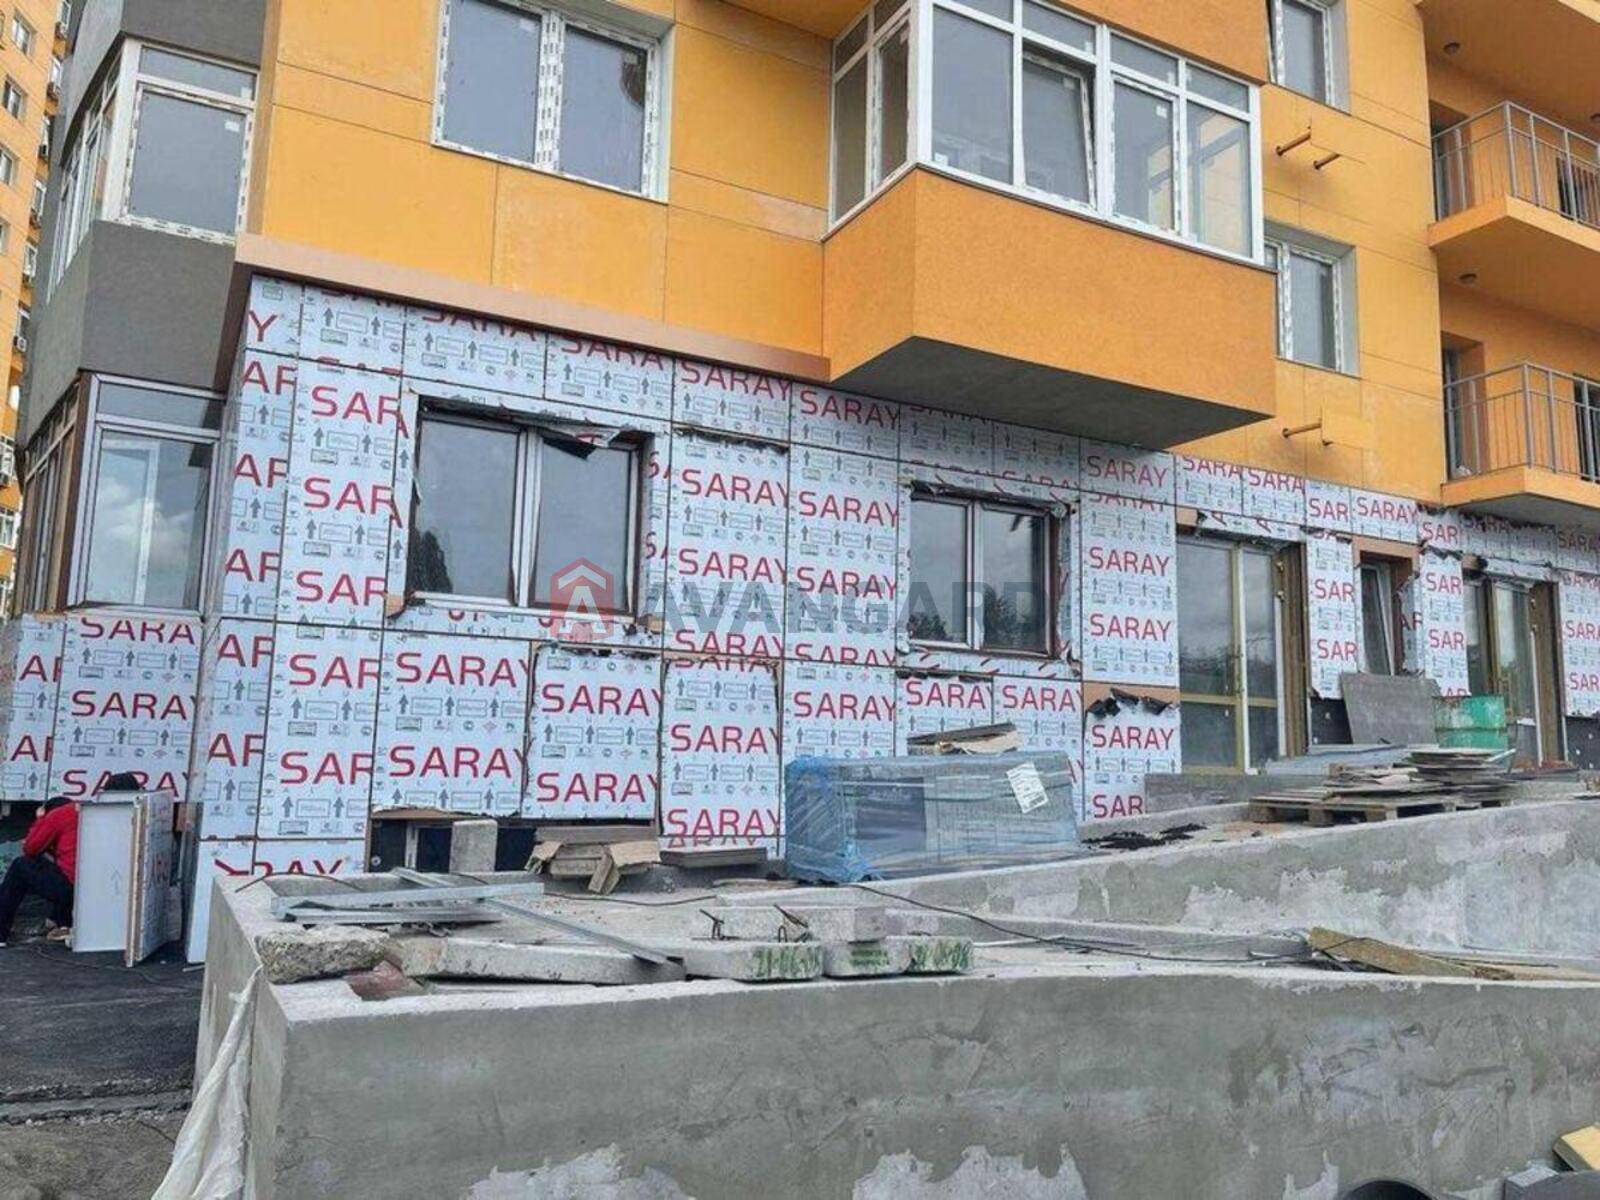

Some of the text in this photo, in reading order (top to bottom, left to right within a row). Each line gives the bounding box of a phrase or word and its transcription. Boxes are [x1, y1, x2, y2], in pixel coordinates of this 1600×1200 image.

[681, 360, 791, 400] SARAY
[801, 390, 900, 430] SARAY
[1087, 455, 1168, 488] SARAY
[798, 490, 900, 528] SARAY
[1357, 496, 1418, 524] SARAY
[1422, 522, 1458, 544] SAR
[1089, 546, 1170, 577] SARAY
[797, 567, 897, 600] SARAY
[1425, 572, 1462, 594] SAR
[1090, 613, 1172, 643] SARAY
[1428, 629, 1465, 649] SAR
[1317, 639, 1357, 661] SAR
[794, 692, 896, 721] SARAY
[1091, 725, 1174, 750] SARAY
